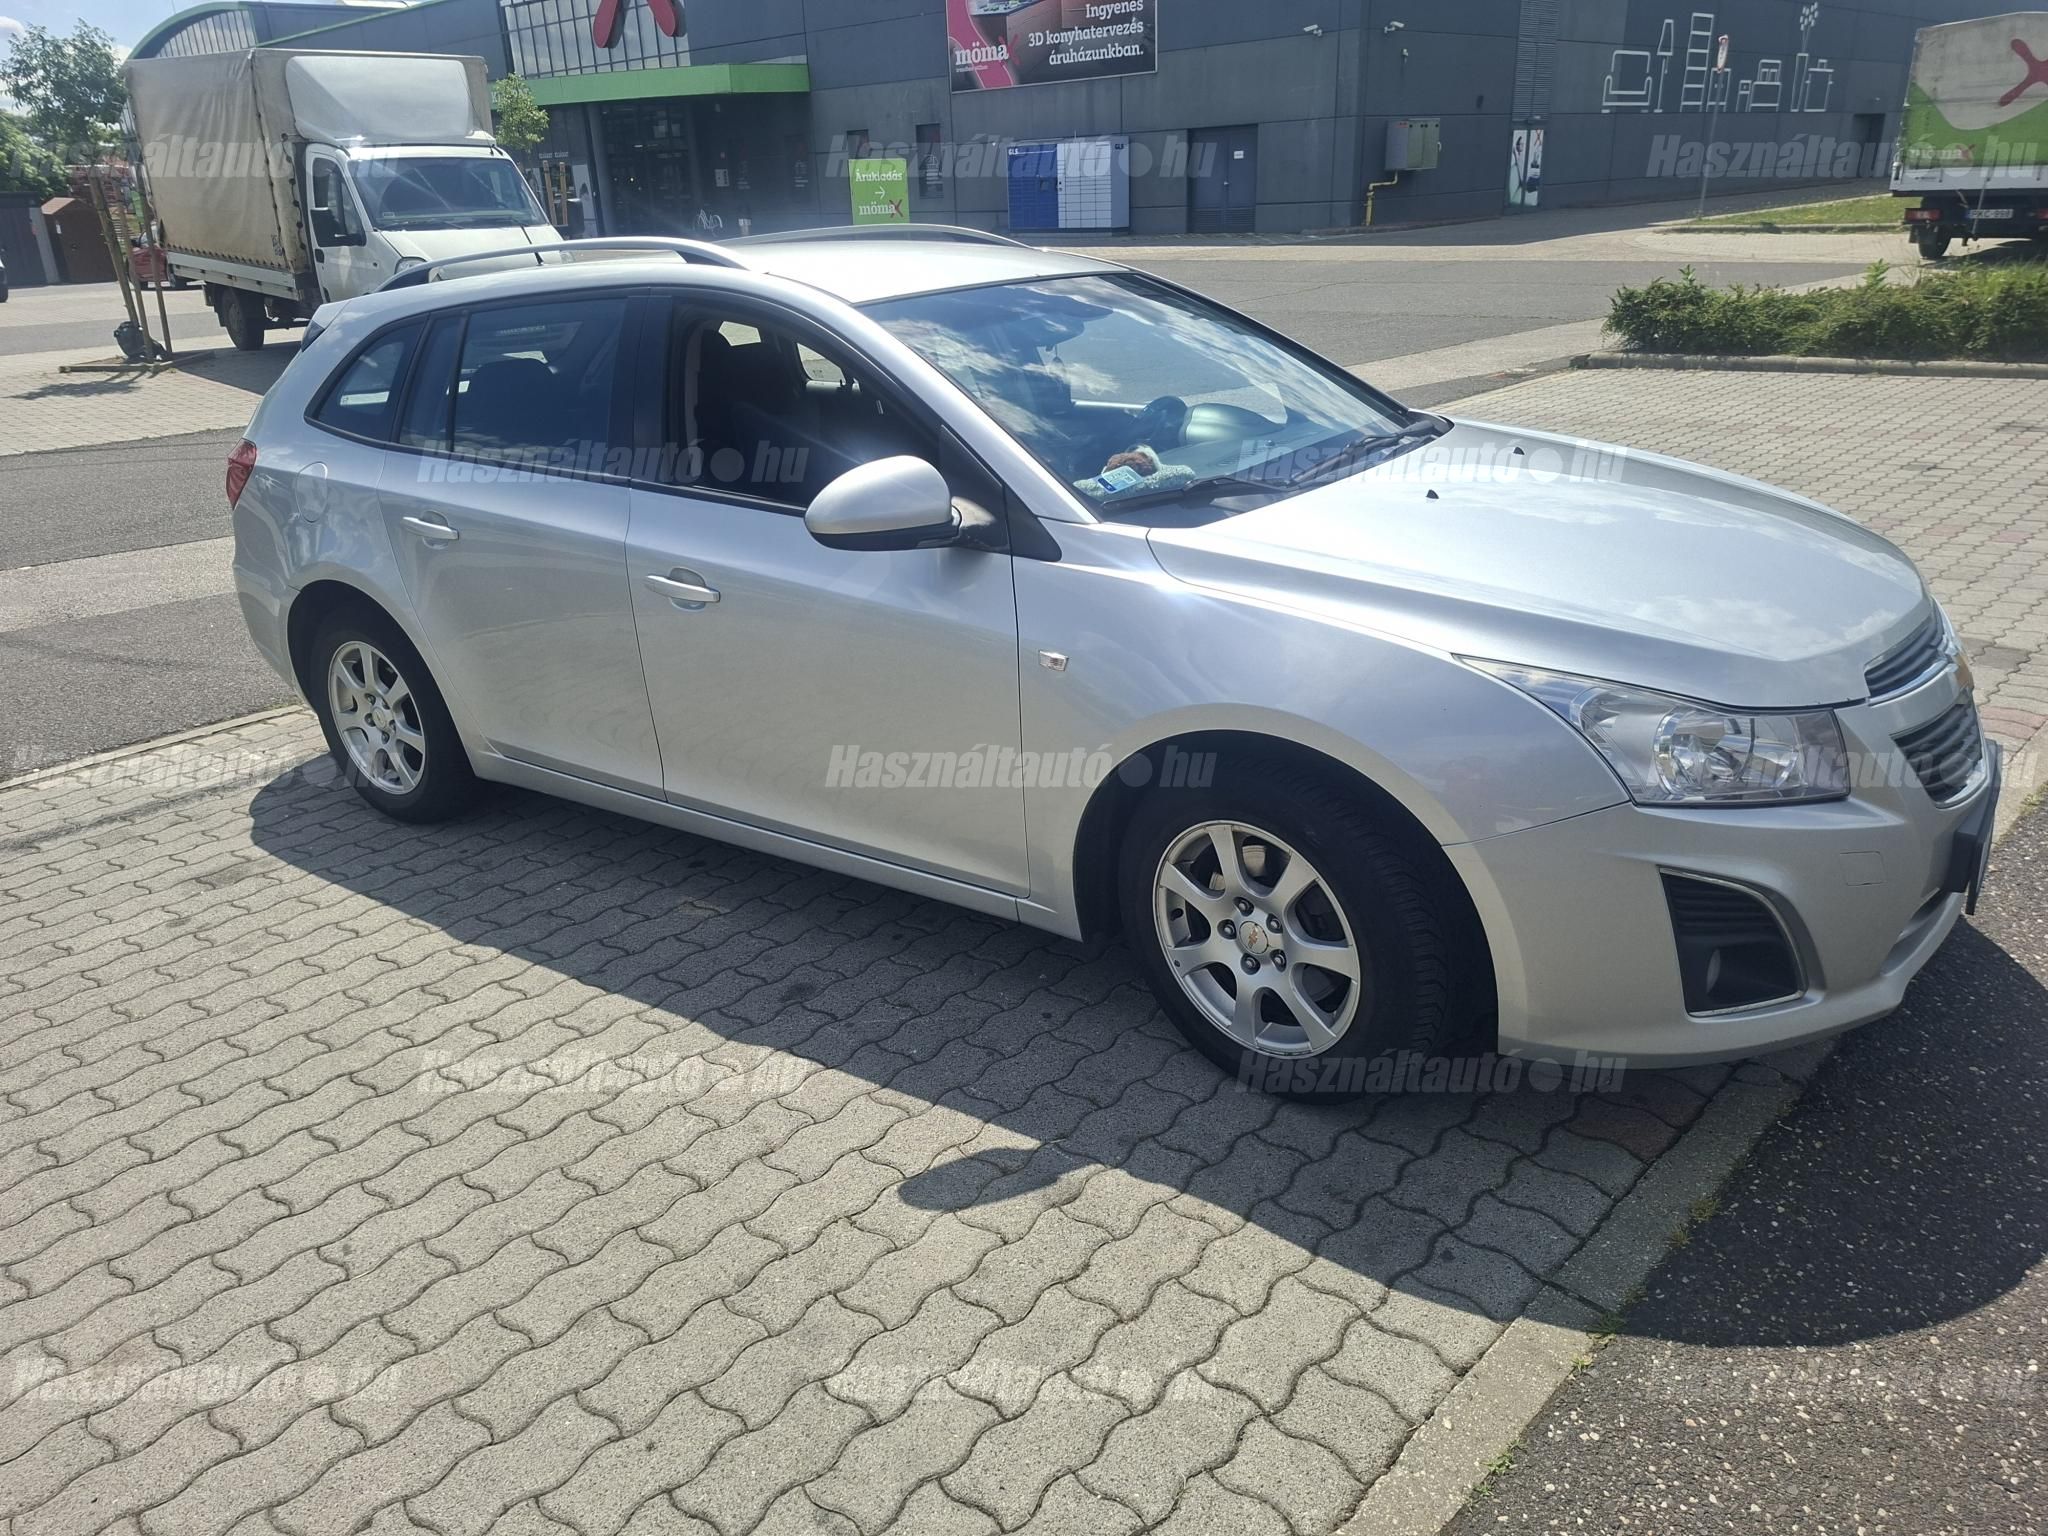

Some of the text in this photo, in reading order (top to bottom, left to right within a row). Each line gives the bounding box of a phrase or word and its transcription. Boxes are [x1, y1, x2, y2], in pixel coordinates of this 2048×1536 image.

[1085, 1, 1144, 19] Ingyenes
[1028, 17, 1144, 47] 3D konyhatervezés
[1049, 43, 1144, 66] áruházunkban.
